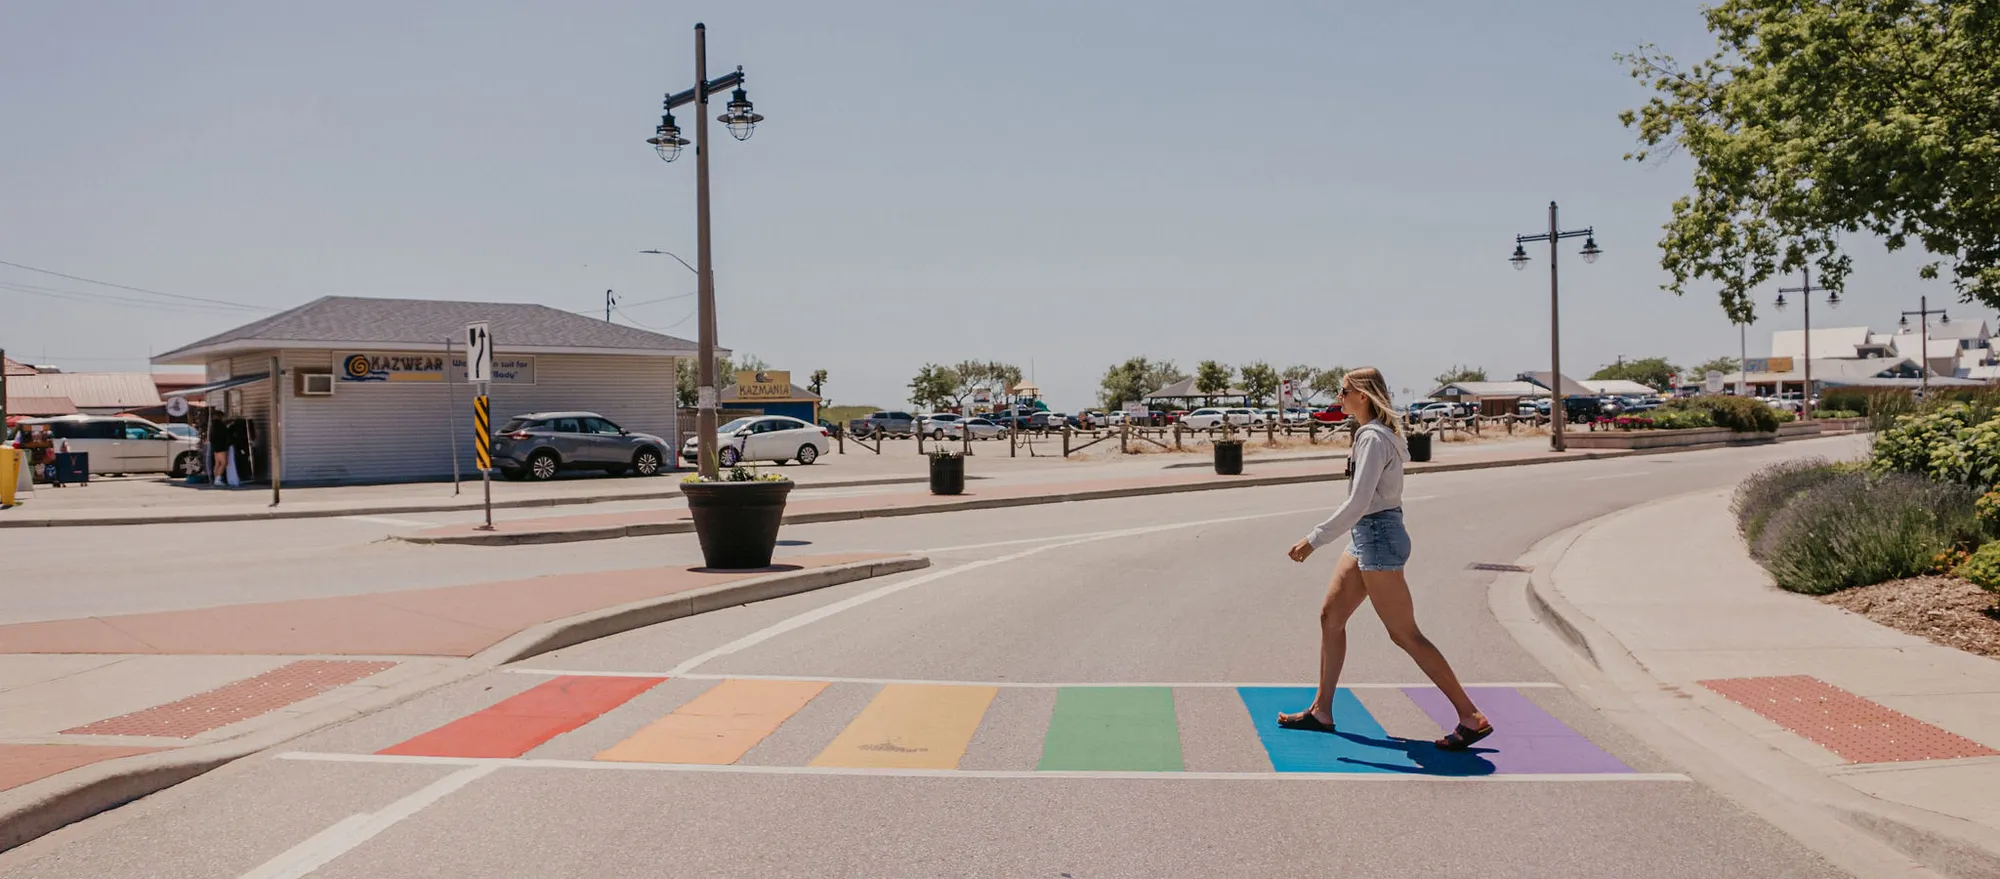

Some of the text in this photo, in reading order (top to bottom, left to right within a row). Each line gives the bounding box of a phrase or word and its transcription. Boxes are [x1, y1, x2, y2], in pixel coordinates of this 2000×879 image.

[371, 355, 443, 371] KAZWEAR
[516, 359, 528, 368] for
[740, 384, 789, 395] KAZMANIA
